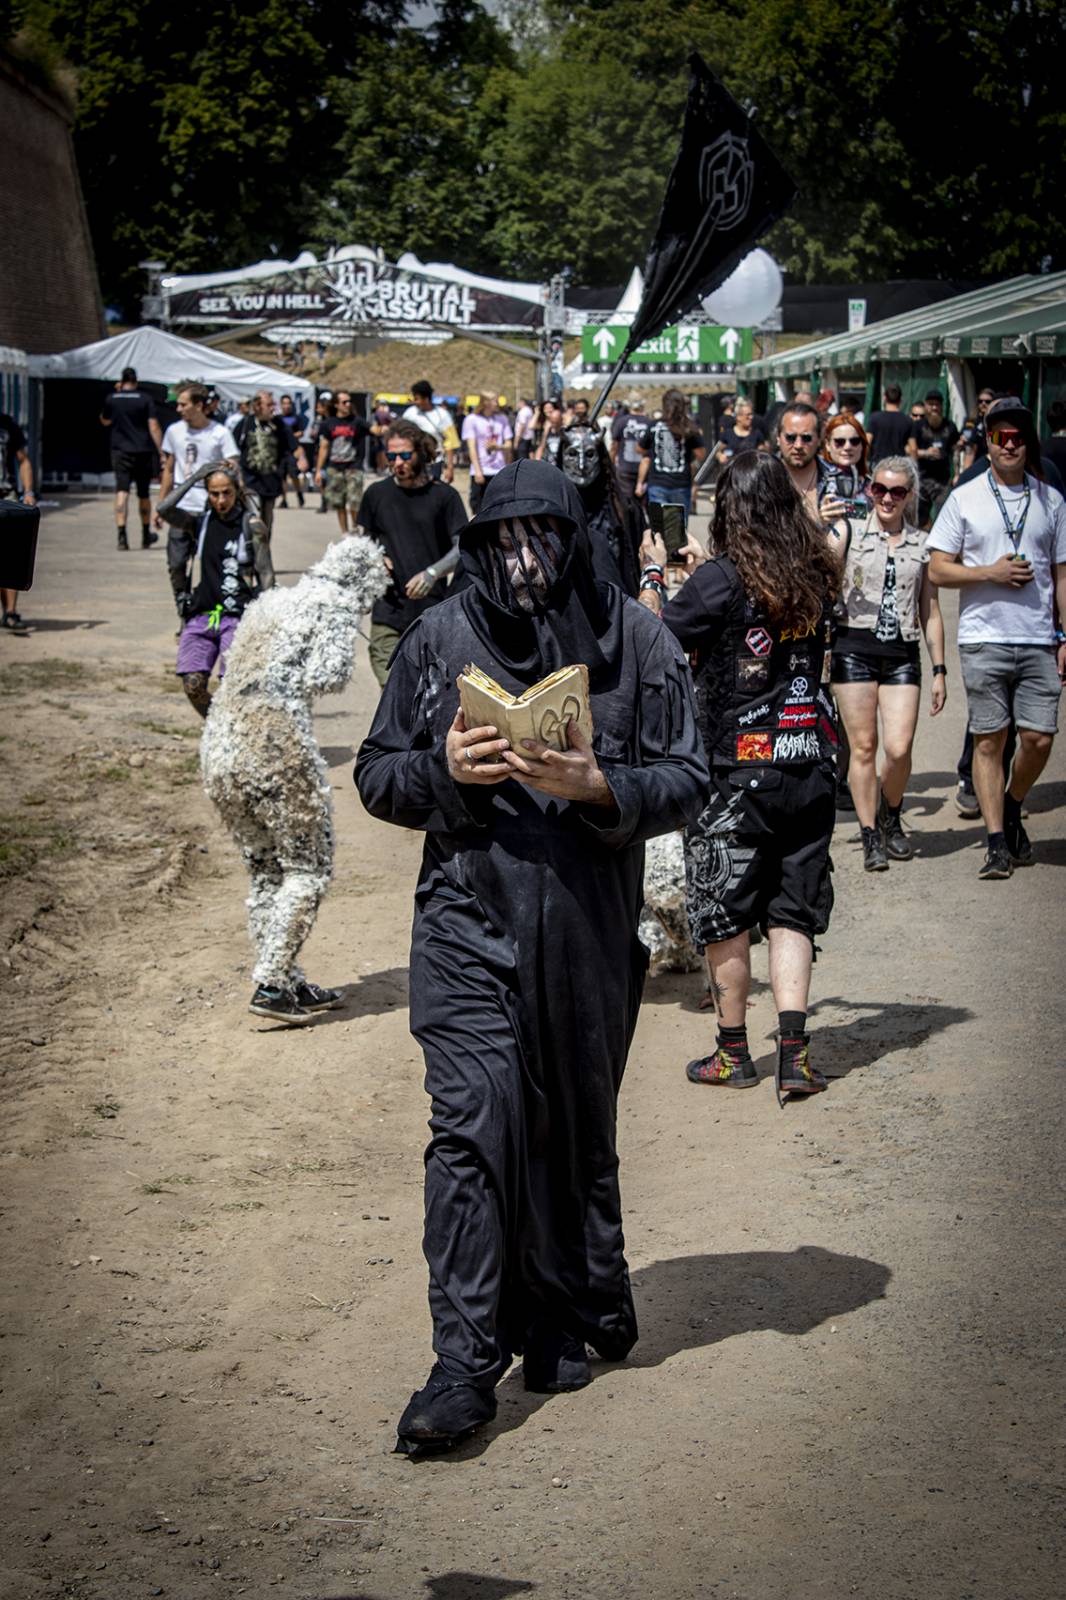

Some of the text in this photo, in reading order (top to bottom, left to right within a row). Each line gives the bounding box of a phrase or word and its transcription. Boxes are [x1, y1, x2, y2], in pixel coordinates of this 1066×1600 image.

[199, 294, 325, 313] SEE YOU IN HELL
[378, 280, 477, 307] BRUTAL
[371, 299, 477, 325] ASSAULT
